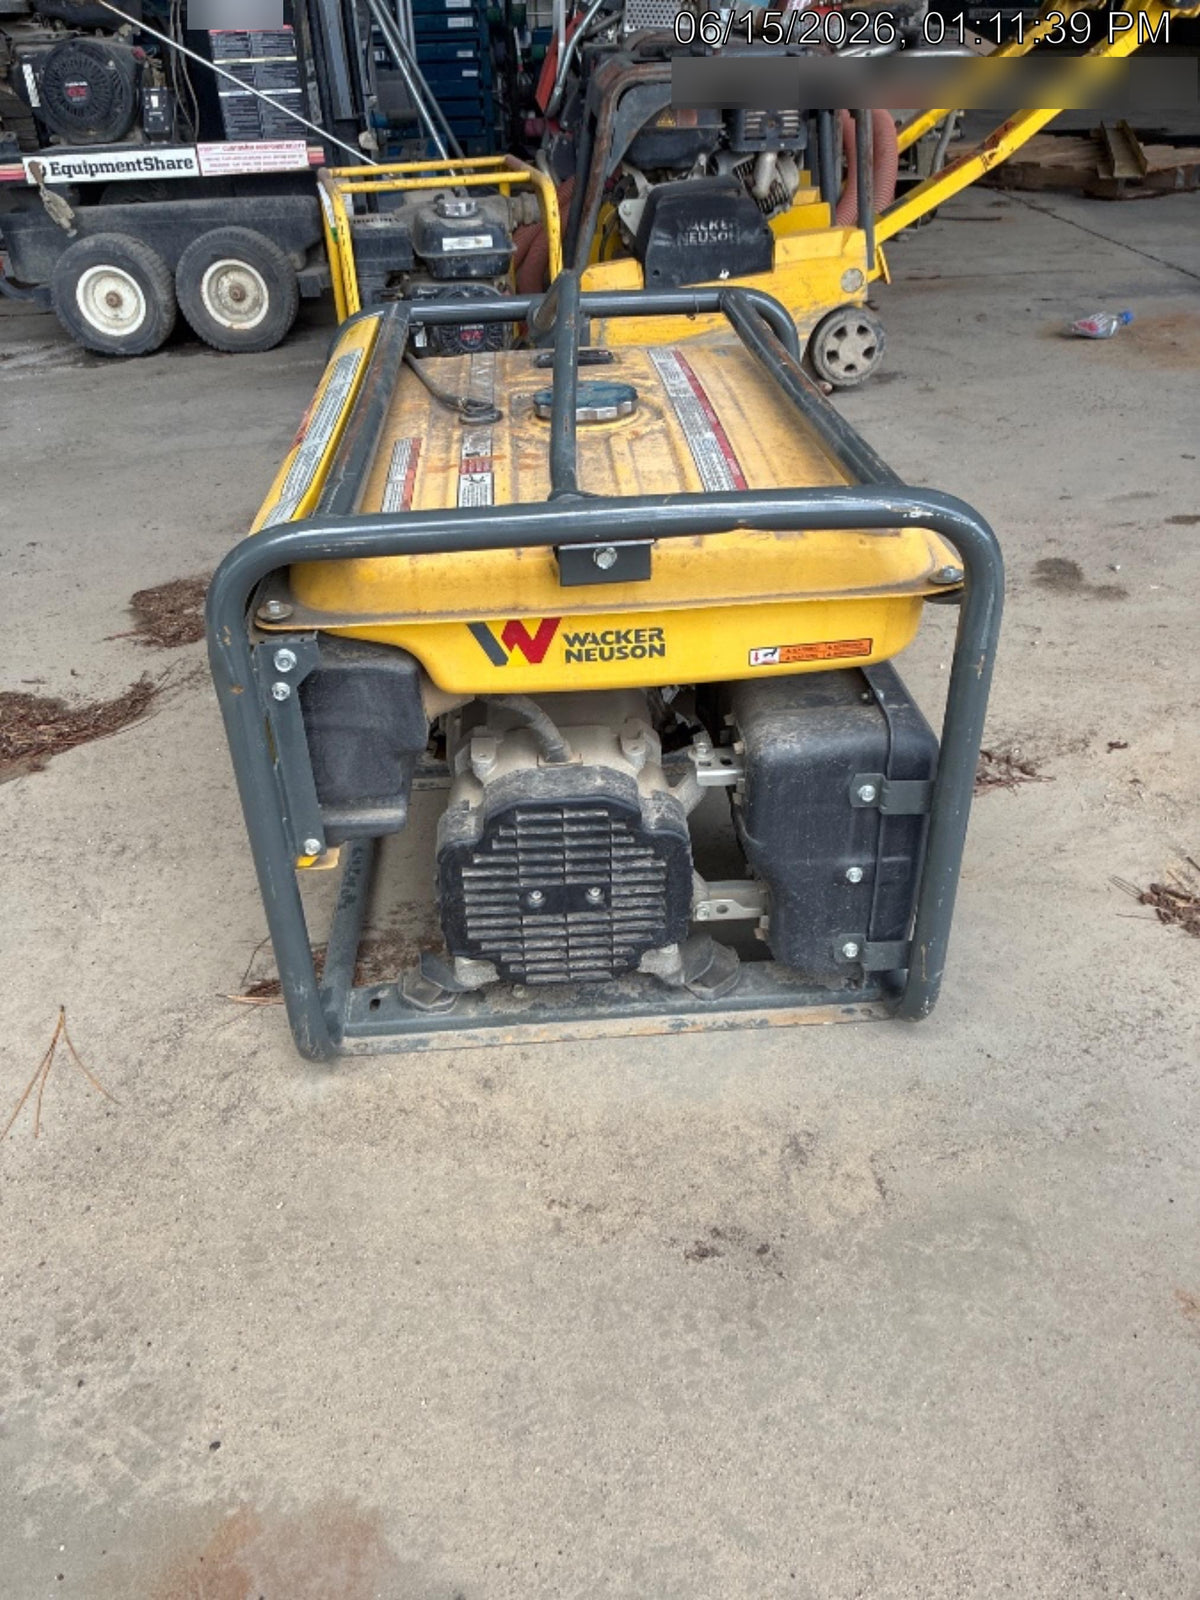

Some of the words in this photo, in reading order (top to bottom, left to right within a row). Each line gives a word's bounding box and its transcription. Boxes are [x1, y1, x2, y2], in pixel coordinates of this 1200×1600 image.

[49, 156, 194, 178] EquipmentShare
[563, 627, 665, 648] WACKER
[565, 643, 666, 664] NEUSON
